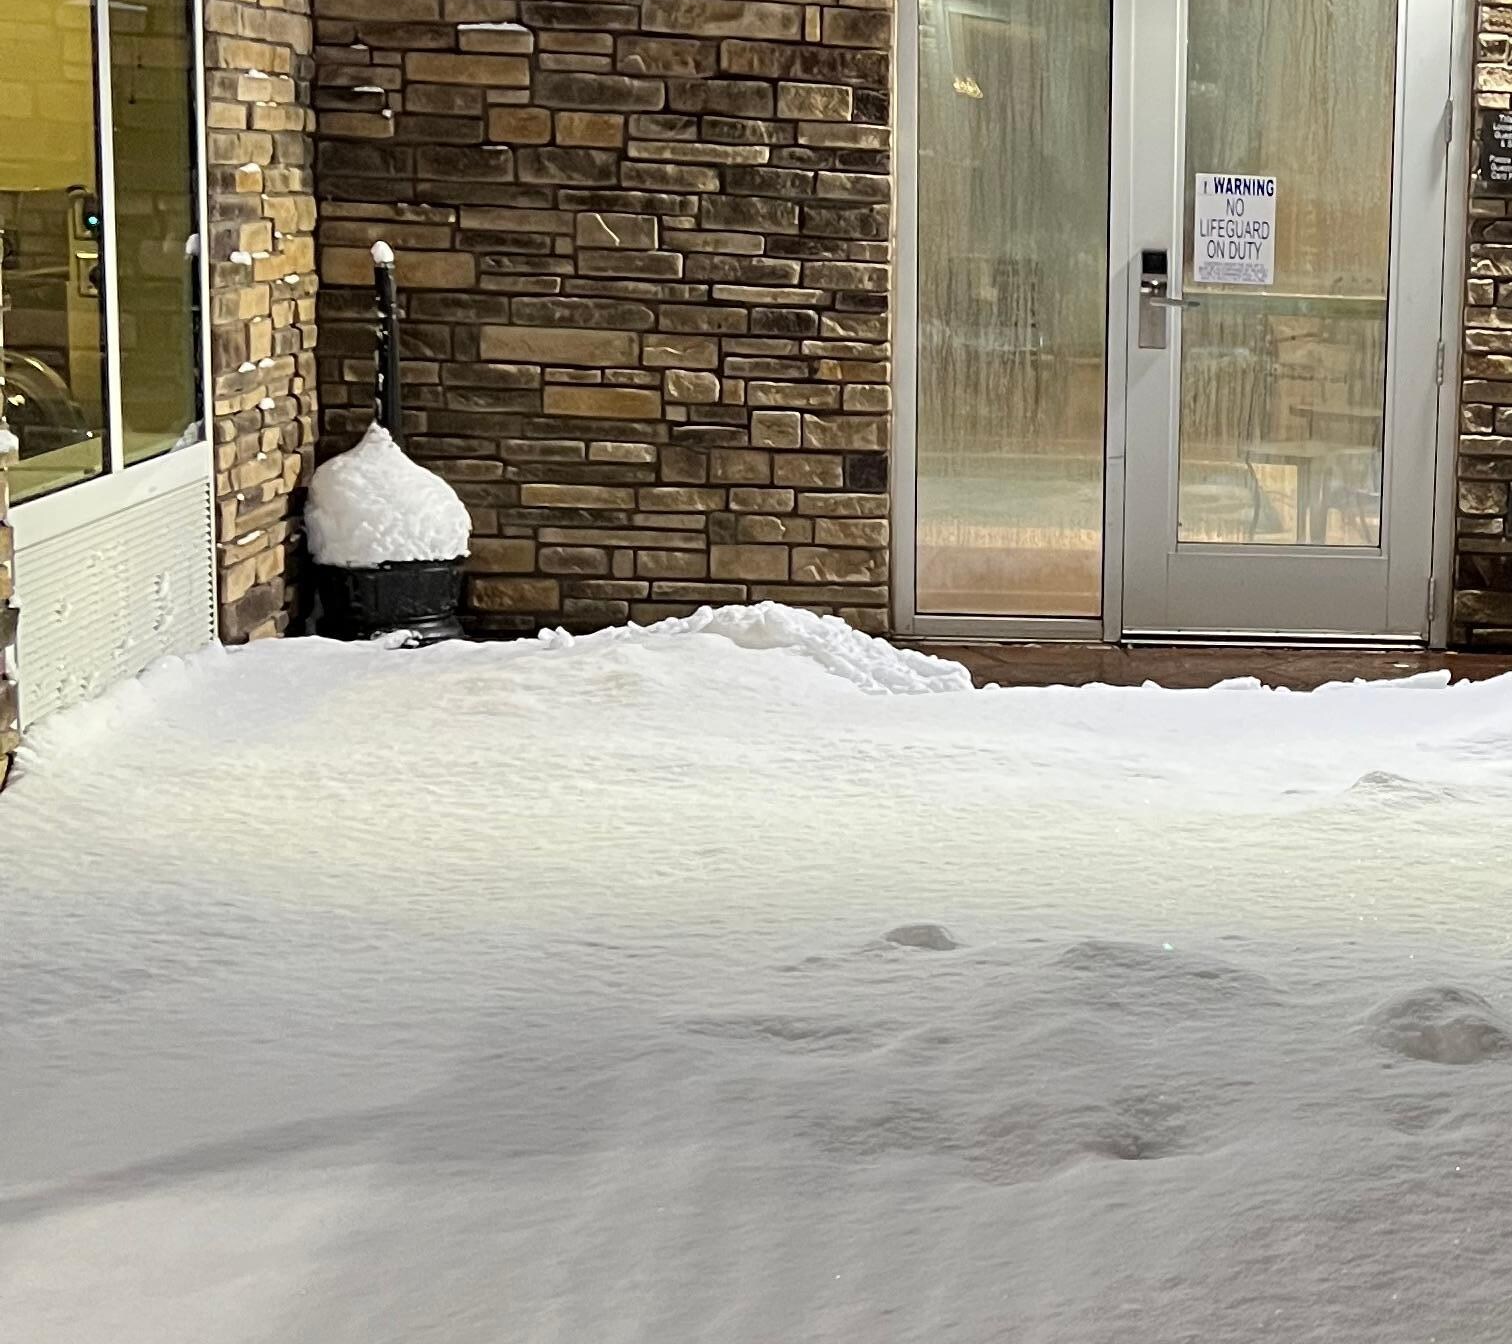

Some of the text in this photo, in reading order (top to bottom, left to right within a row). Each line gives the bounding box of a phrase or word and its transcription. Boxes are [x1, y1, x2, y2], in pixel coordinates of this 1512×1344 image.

[1213, 177, 1275, 197] WARNING
[1226, 198, 1245, 217] NO
[1200, 218, 1271, 240] LIFEGUARD
[1206, 239, 1263, 261] ON DUTY
